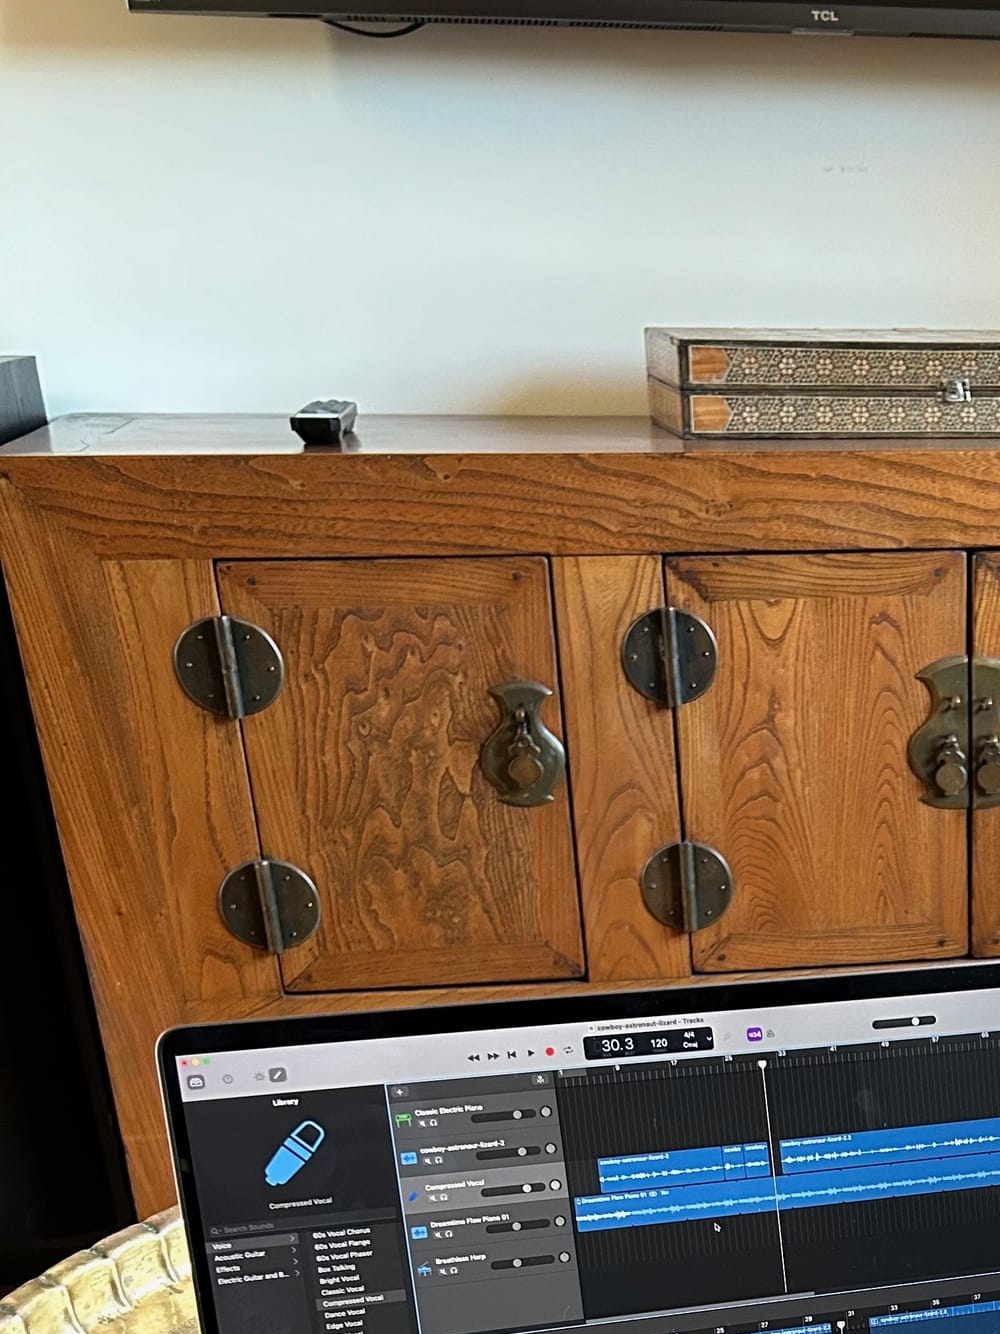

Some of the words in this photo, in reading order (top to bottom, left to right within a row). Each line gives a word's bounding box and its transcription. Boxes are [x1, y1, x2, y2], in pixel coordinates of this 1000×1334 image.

[811, 10, 838, 21] TCL
[601, 1037, 634, 1052] 30.3
[650, 1038, 668, 1048] 120
[272, 1098, 299, 1107] Library
[414, 1108, 438, 1116] Classic
[440, 1105, 464, 1114] Electric
[465, 1104, 483, 1112] Piano
[425, 1181, 465, 1191] Compressed
[466, 1179, 485, 1187] Vocal
[269, 1200, 312, 1210] Compressed
[313, 1197, 332, 1206] Vocal
[483, 1215, 500, 1223] Piano
[327, 1229, 345, 1238] Vocal
[346, 1227, 371, 1236] Chorus
[212, 1242, 232, 1250] Voice
[329, 1241, 347, 1249] Vocal
[214, 1252, 243, 1262] Acoustic
[245, 1250, 265, 1259] Guitar
[330, 1252, 349, 1261] Vocal
[350, 1250, 373, 1258] Phaser
[216, 1264, 240, 1273] Effects
[317, 1266, 331, 1274] Box
[332, 1263, 356, 1272] Talking
[218, 1275, 243, 1285] Electric
[244, 1273, 264, 1282] Guitar
[264, 1272, 278, 1280] and
[319, 1276, 339, 1285] Bright
[340, 1274, 360, 1283] Vocal
[321, 1287, 345, 1296] Classic
[346, 1285, 365, 1293] Vocal
[322, 1297, 365, 1308] Compressed
[366, 1294, 384, 1303] Vocal
[324, 1311, 346, 1319] Dance
[347, 1308, 366, 1317] Vocal
[326, 1322, 344, 1331] Edge
[344, 1319, 363, 1328] Vocal
